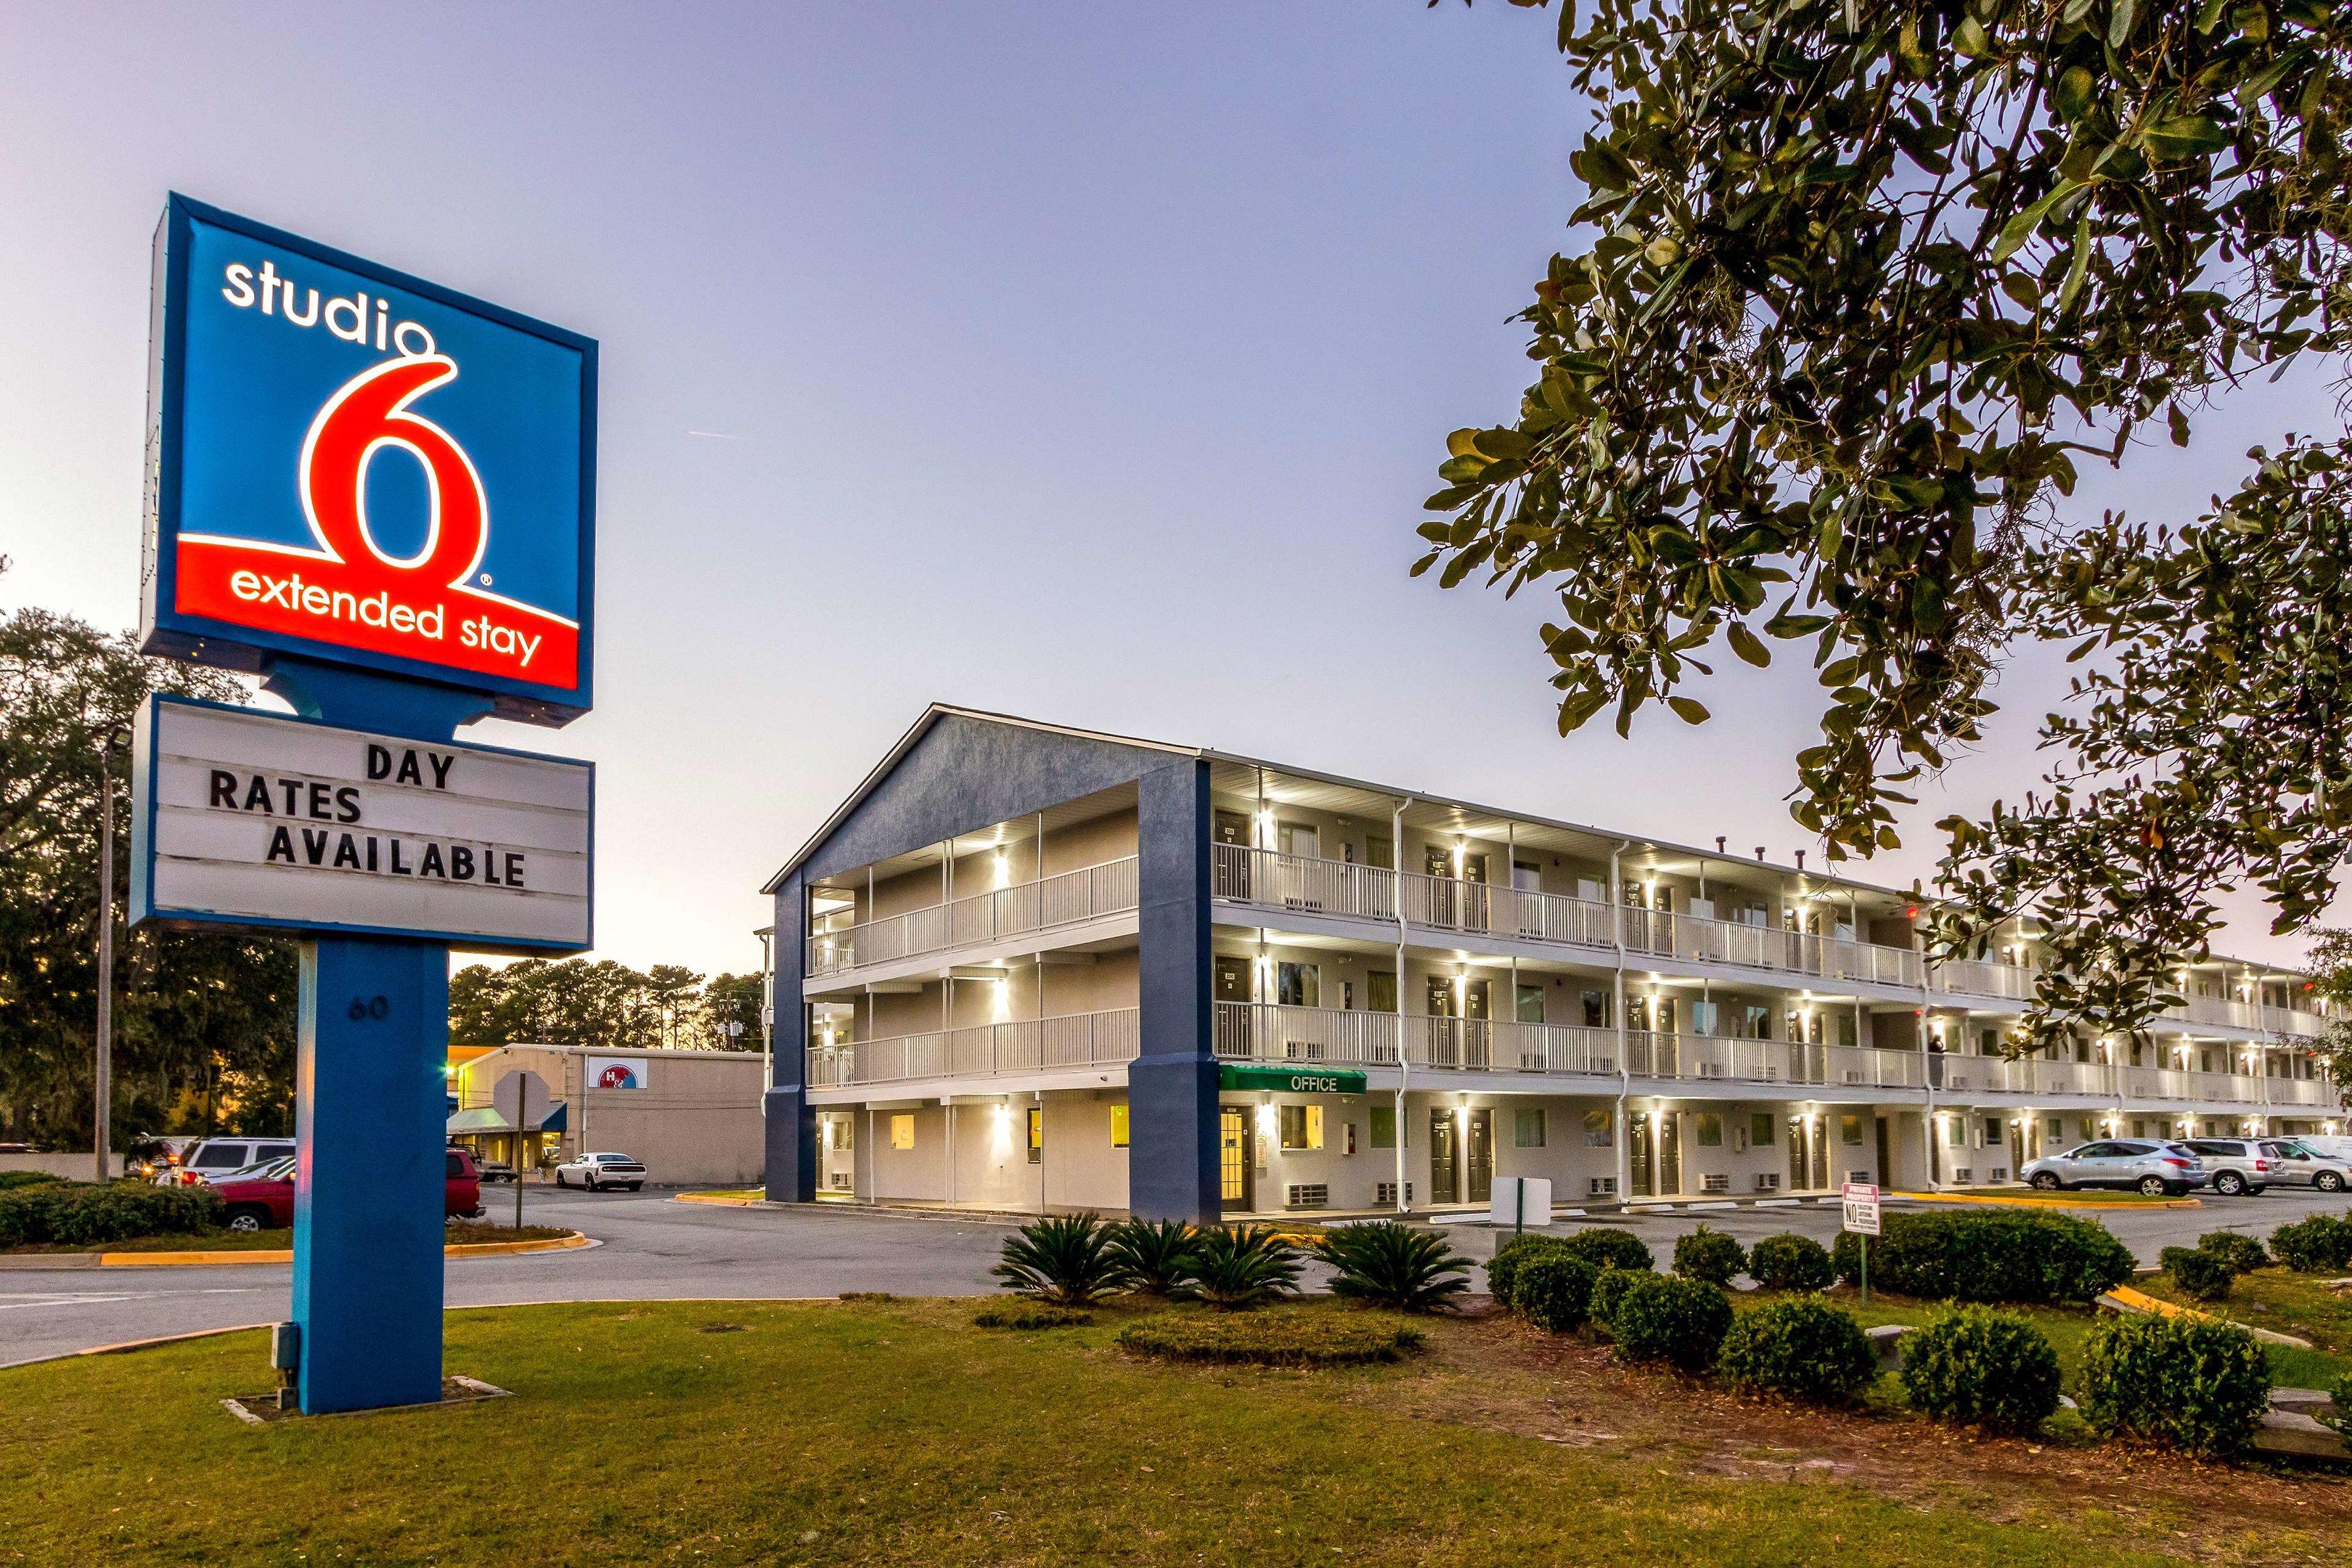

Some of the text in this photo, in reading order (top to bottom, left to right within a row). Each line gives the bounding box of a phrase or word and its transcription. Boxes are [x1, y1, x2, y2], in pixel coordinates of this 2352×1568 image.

[222, 261, 436, 359] studio
[299, 354, 489, 587] 6
[230, 569, 542, 666] extended stay
[367, 744, 454, 789] DAY
[210, 769, 362, 822] RATES
[266, 826, 525, 888] AVAILABLE
[347, 995, 389, 1020] 60
[606, 1071, 616, 1082] H
[1291, 1076, 1337, 1092] OFFICE
[1846, 1193, 1875, 1202] PROPERTY
[1846, 1204, 1857, 1223] NO
